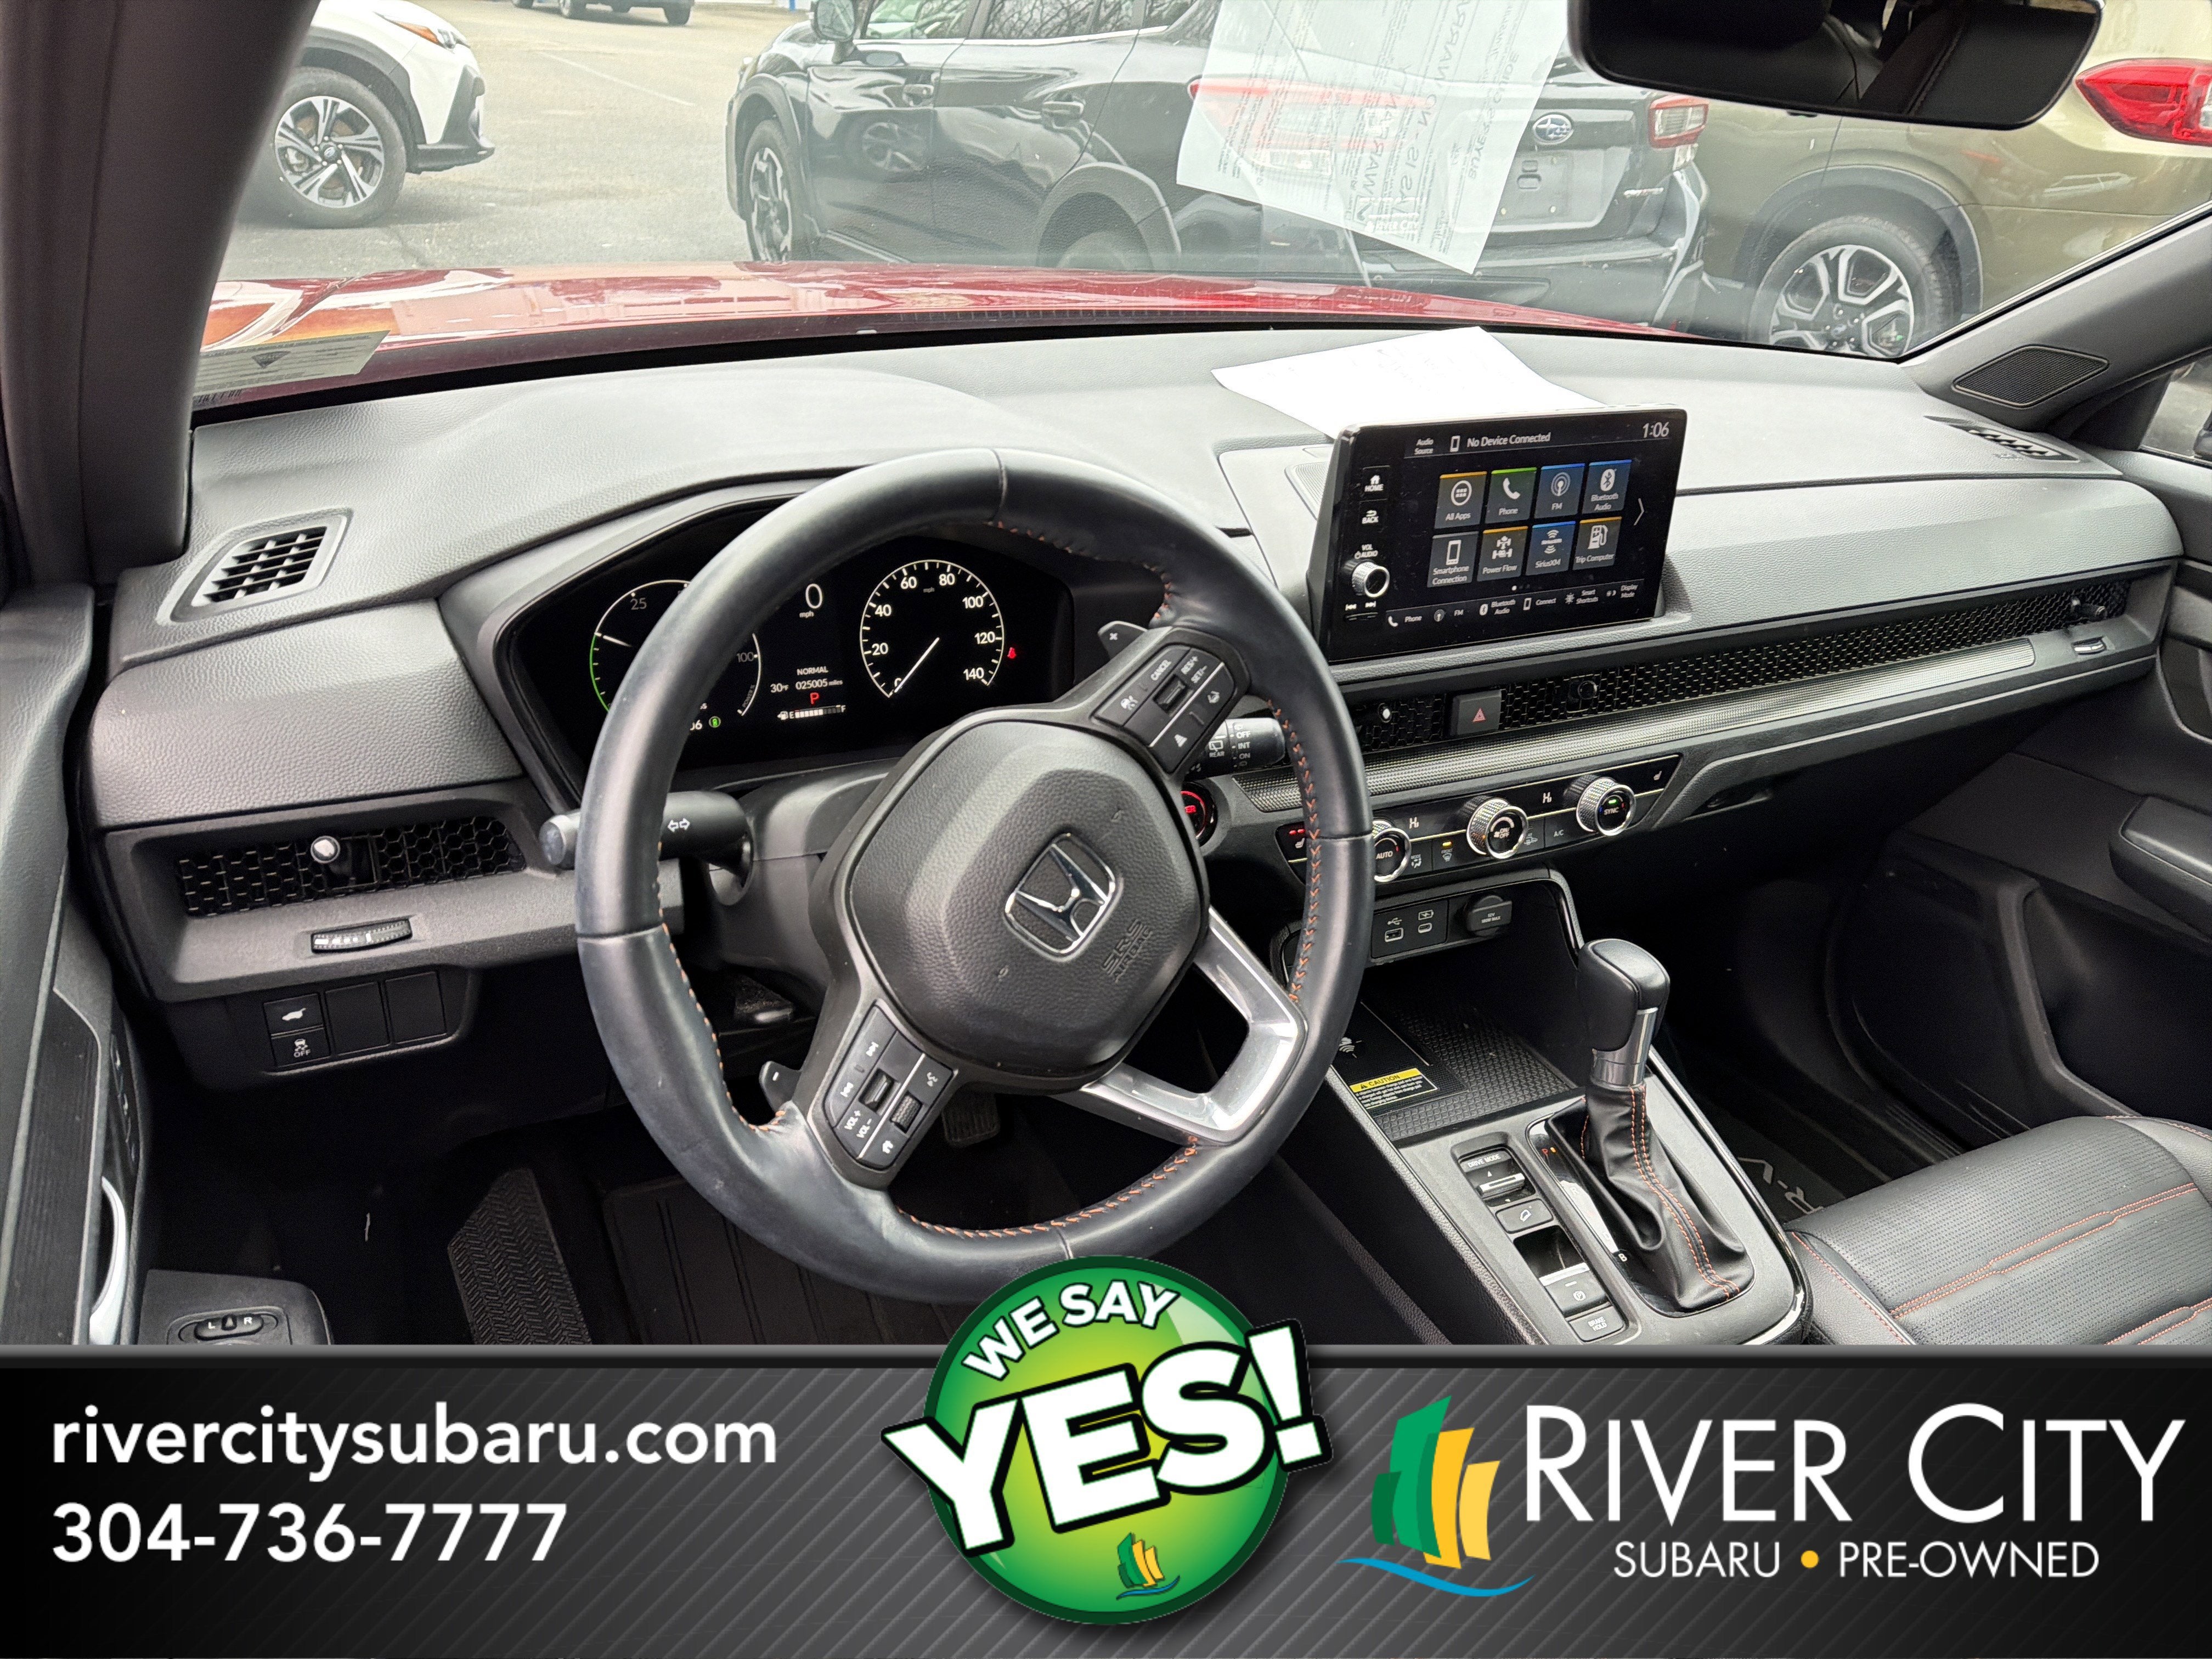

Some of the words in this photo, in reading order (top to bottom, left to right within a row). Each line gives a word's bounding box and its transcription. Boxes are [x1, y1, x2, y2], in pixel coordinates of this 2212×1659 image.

[1643, 421, 1669, 438] 1:06
[1416, 438, 1434, 446] Audio
[1466, 438, 1480, 447] No
[1481, 436, 1508, 447] Device
[1509, 432, 1551, 444] Connected
[1365, 484, 1383, 492] HOME
[1591, 493, 1619, 502] Bluetooth
[1498, 507, 1519, 516] Phone
[1594, 503, 1612, 511] Audio
[1362, 516, 1379, 524] BACK
[1445, 513, 1454, 521] All
[1454, 512, 1471, 521] Apps
[1535, 558, 1561, 568] SiriusXM
[1575, 555, 1586, 564] Trip
[1587, 553, 1616, 562] Computer
[1432, 565, 1470, 575] Smartphone
[1482, 566, 1502, 574] Power
[900, 576, 917, 589] 60
[939, 573, 956, 586] 80
[1432, 575, 1468, 585] Connection
[805, 583, 823, 609] 0
[630, 597, 647, 610] 25
[962, 596, 984, 609] 100
[874, 604, 891, 617] 40
[974, 631, 996, 645] 120
[871, 642, 888, 656] 20
[736, 651, 754, 663] 100
[797, 665, 829, 675] NORMAL
[963, 667, 984, 680] 140
[795, 678, 828, 690] 025005
[810, 692, 820, 704] P
[789, 711, 794, 719] E
[1236, 730, 1251, 739] OFF
[1238, 741, 1250, 749] INT
[1375, 851, 1393, 860] AUTO
[1101, 918, 1143, 975] SRS
[294, 1049, 311, 1058] OFF
[1368, 1074, 1401, 1087] CAUTION
[1467, 1158, 1485, 1169] DRIVE
[1485, 1153, 1502, 1164] MODE
[1618, 1253, 1628, 1262] B
[244, 1317, 252, 1325] R
[1588, 1316, 1606, 1327] BRAKE
[1592, 1322, 1607, 1331] HOLD
